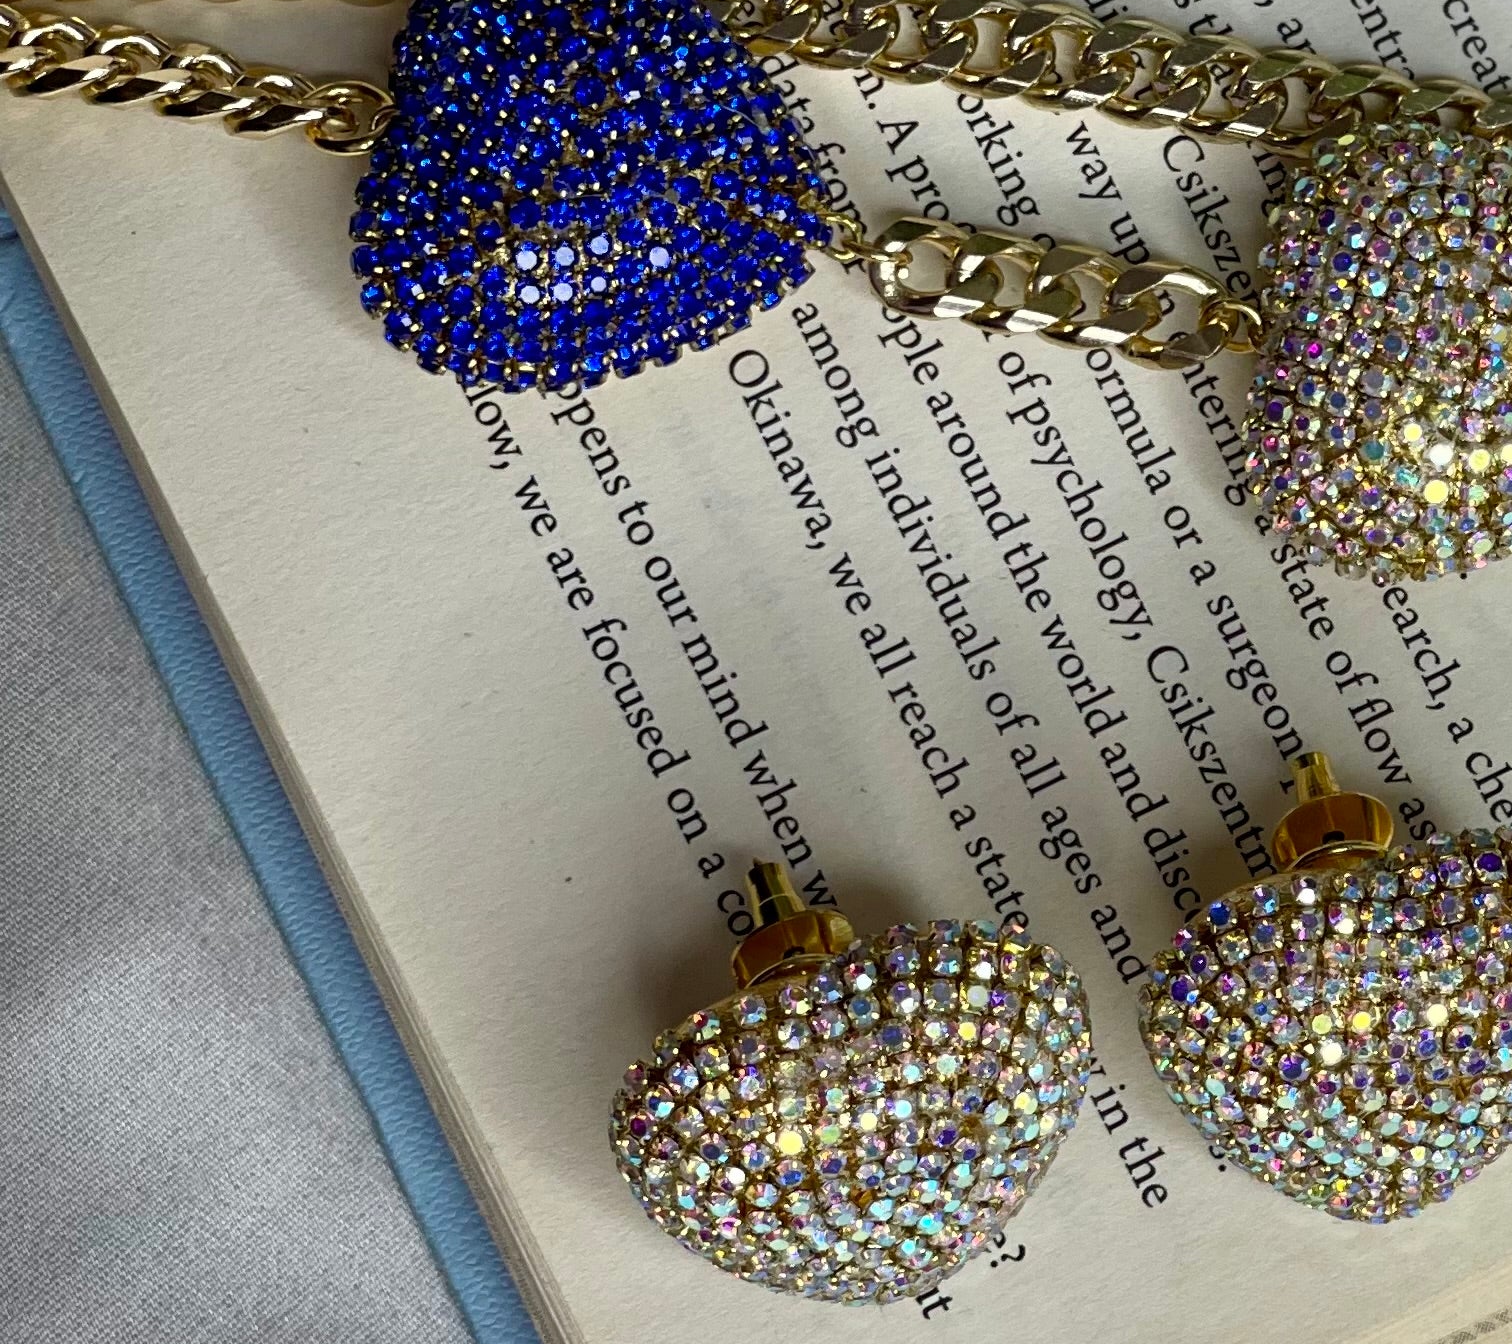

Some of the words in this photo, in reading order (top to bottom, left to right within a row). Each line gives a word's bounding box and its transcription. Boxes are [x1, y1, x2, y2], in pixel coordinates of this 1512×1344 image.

[790, 302, 880, 449] among
[728, 348, 833, 550] Okinawa,
[828, 551, 872, 616] we
[864, 447, 1001, 681] individuals
[514, 474, 558, 538] we
[545, 546, 595, 611] are
[581, 618, 692, 779] focused
[666, 787, 708, 845] on
[697, 852, 726, 880] a
[617, 500, 655, 547] to
[643, 555, 699, 628] our
[680, 633, 770, 749] mind
[742, 748, 813, 870] when
[859, 623, 917, 679] all
[887, 681, 970, 799] reach
[985, 691, 1041, 736] of
[948, 804, 977, 832] a
[1009, 743, 1068, 799] all
[963, 836, 1030, 935] state
[1038, 805, 1103, 895] ages
[1089, 904, 1164, 985] and
